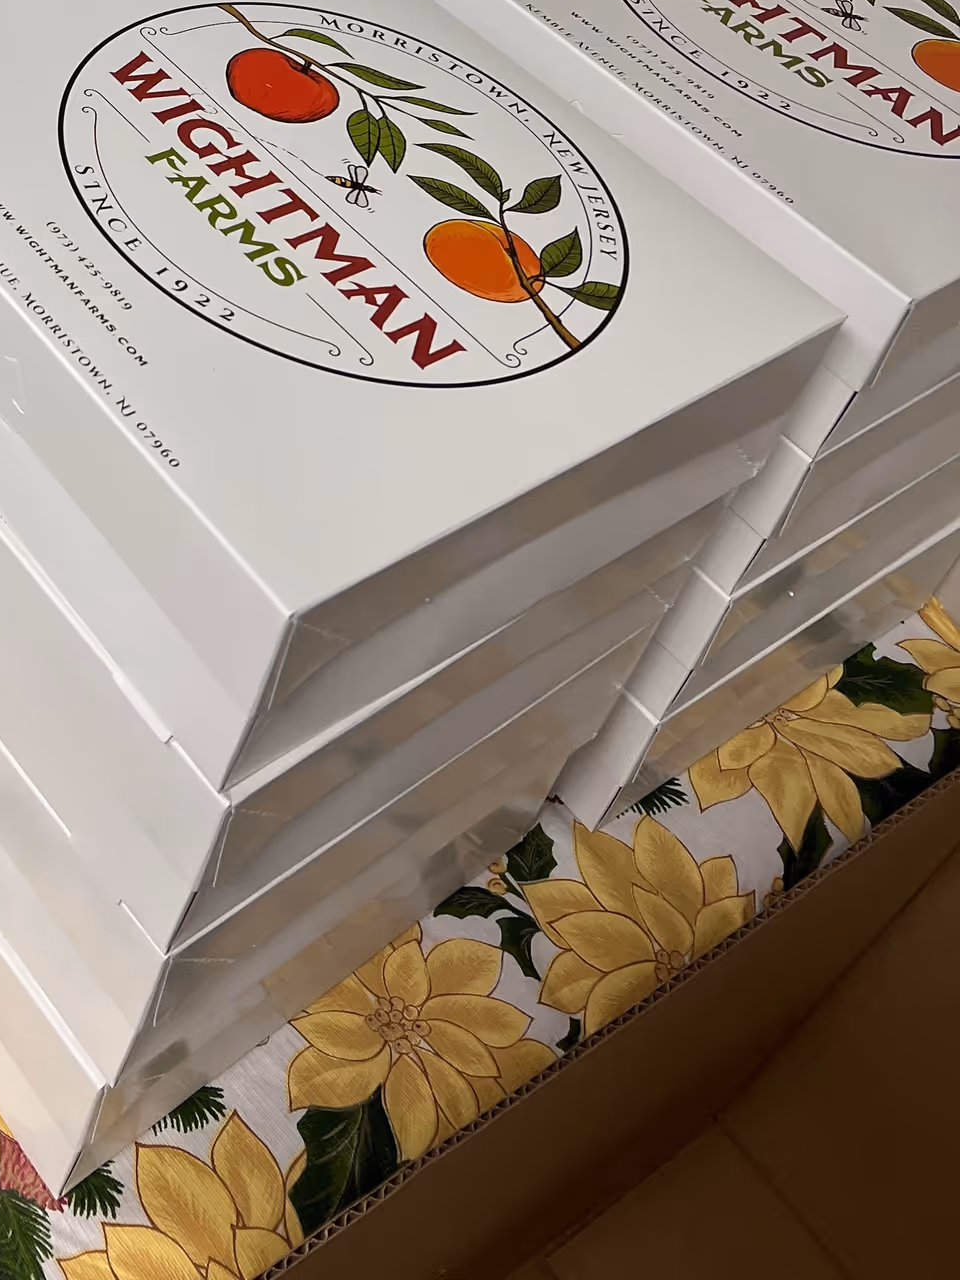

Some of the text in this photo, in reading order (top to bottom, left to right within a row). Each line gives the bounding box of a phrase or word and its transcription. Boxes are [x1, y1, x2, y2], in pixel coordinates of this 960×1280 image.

[317, 14, 619, 262] MORRISTOWN, NEW JERSEY
[525, 3, 575, 38] KEMBLE
[575, 40, 627, 81] AVENUE,
[631, 81, 726, 154] MORRISTOWN,
[730, 155, 749, 169] NJ
[752, 172, 795, 204] 07960
[626, 34, 715, 99] (973) 425-9819
[720, 69, 791, 111] 1922
[46, 220, 134, 312] (973) 425-9819
[75, 164, 237, 323] SINCE 1922
[109, 51, 469, 370] WIGHTMAN
[145, 146, 308, 289] FARMS
[21, 292, 113, 395] MORRISTOWN,
[115, 395, 138, 417] NJ
[136, 422, 181, 468] 07960
